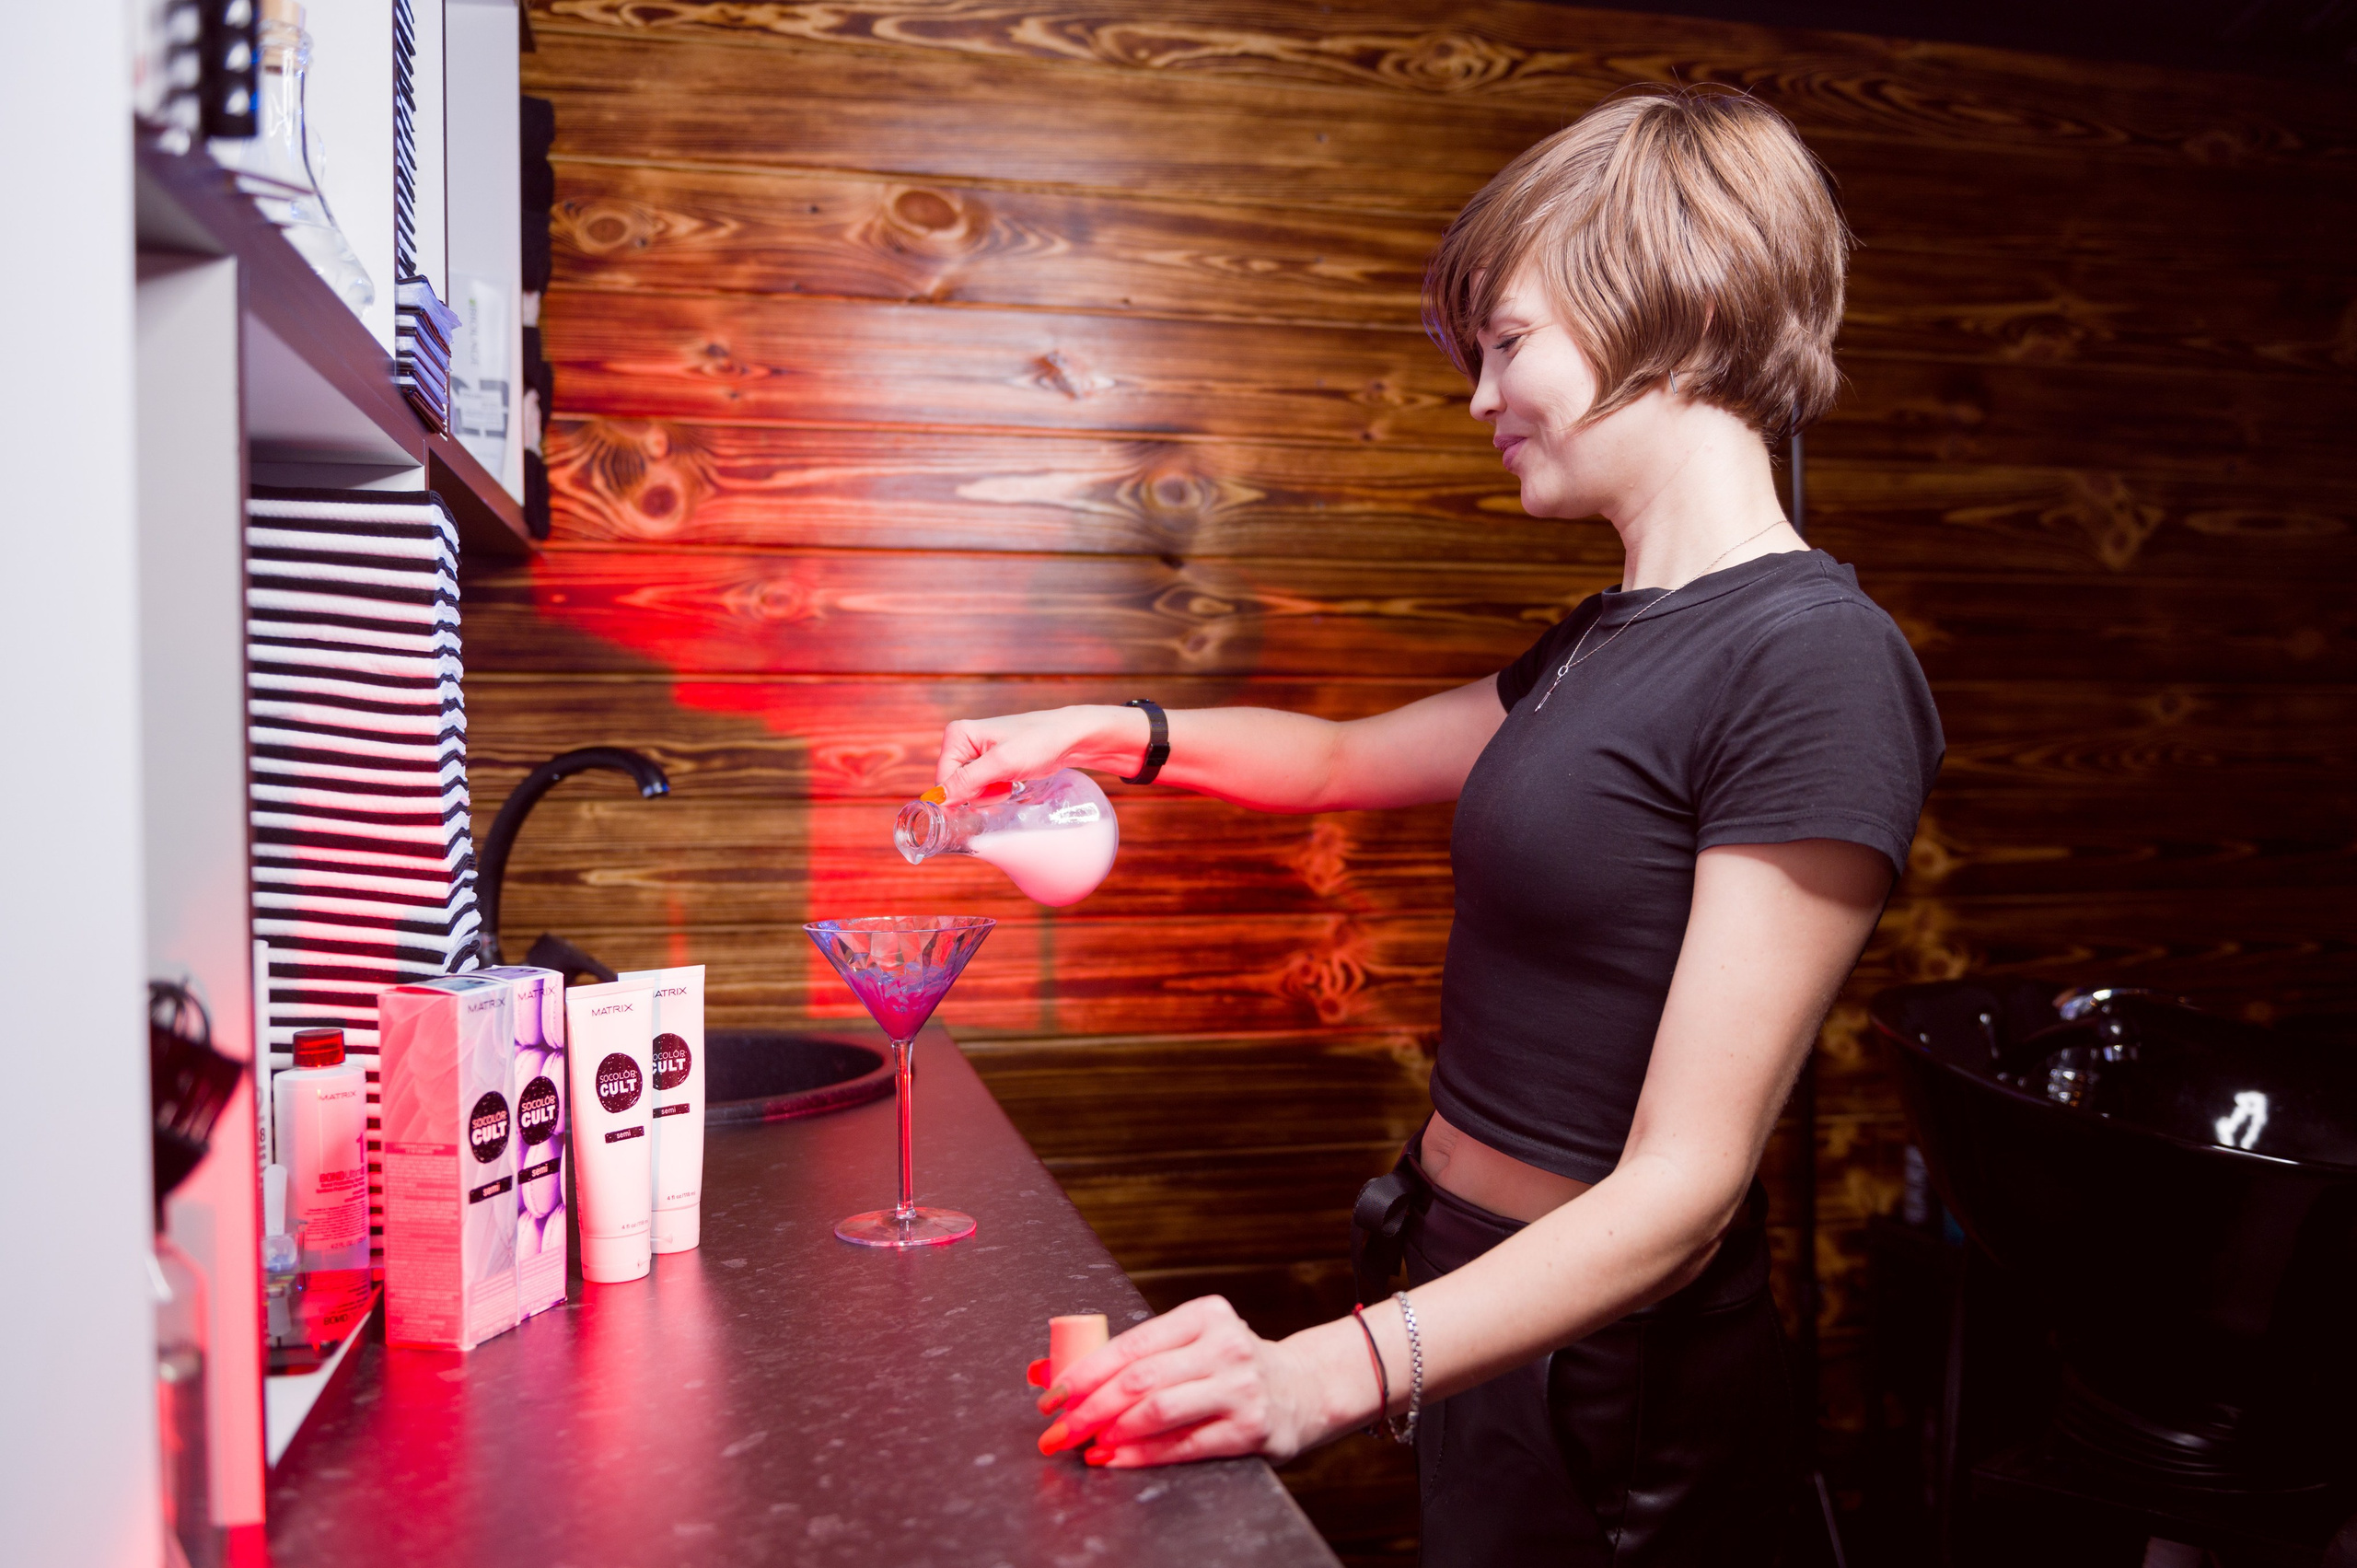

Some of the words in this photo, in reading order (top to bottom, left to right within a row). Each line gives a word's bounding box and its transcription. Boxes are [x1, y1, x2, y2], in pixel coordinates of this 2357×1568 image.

[517, 986, 556, 1001] MATRIX
[653, 987, 687, 998] ATRIX
[468, 997, 505, 1013] MATRIX
[592, 1004, 633, 1016] MATRIX
[599, 1078, 637, 1098] CULT
[319, 1090, 357, 1101] MATRIX
[521, 1105, 556, 1128] CULT
[661, 1107, 677, 1115] semi
[471, 1121, 507, 1146] CULT
[616, 1130, 632, 1140] semi
[532, 1164, 549, 1178] semi
[482, 1182, 501, 1197] semi
